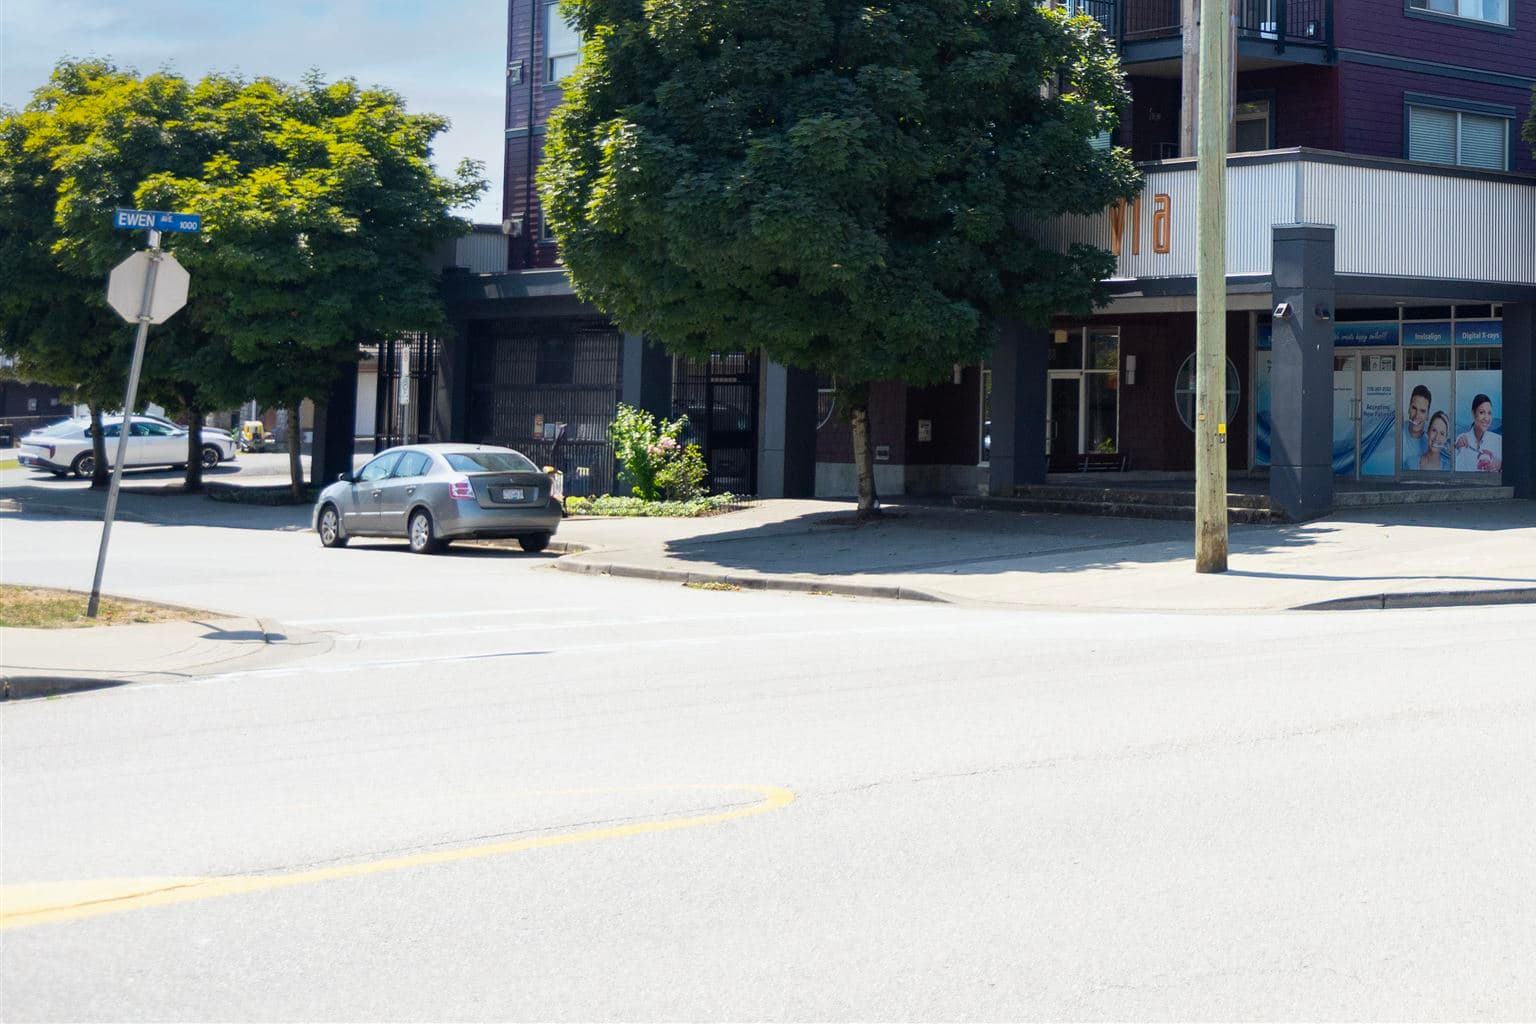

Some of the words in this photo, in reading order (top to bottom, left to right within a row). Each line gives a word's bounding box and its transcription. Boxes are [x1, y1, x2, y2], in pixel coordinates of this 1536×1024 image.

[118, 212, 155, 227] EWEN
[180, 222, 197, 230] 1000
[1462, 331, 1481, 340] Digital
[1482, 331, 1500, 341] X-rays
